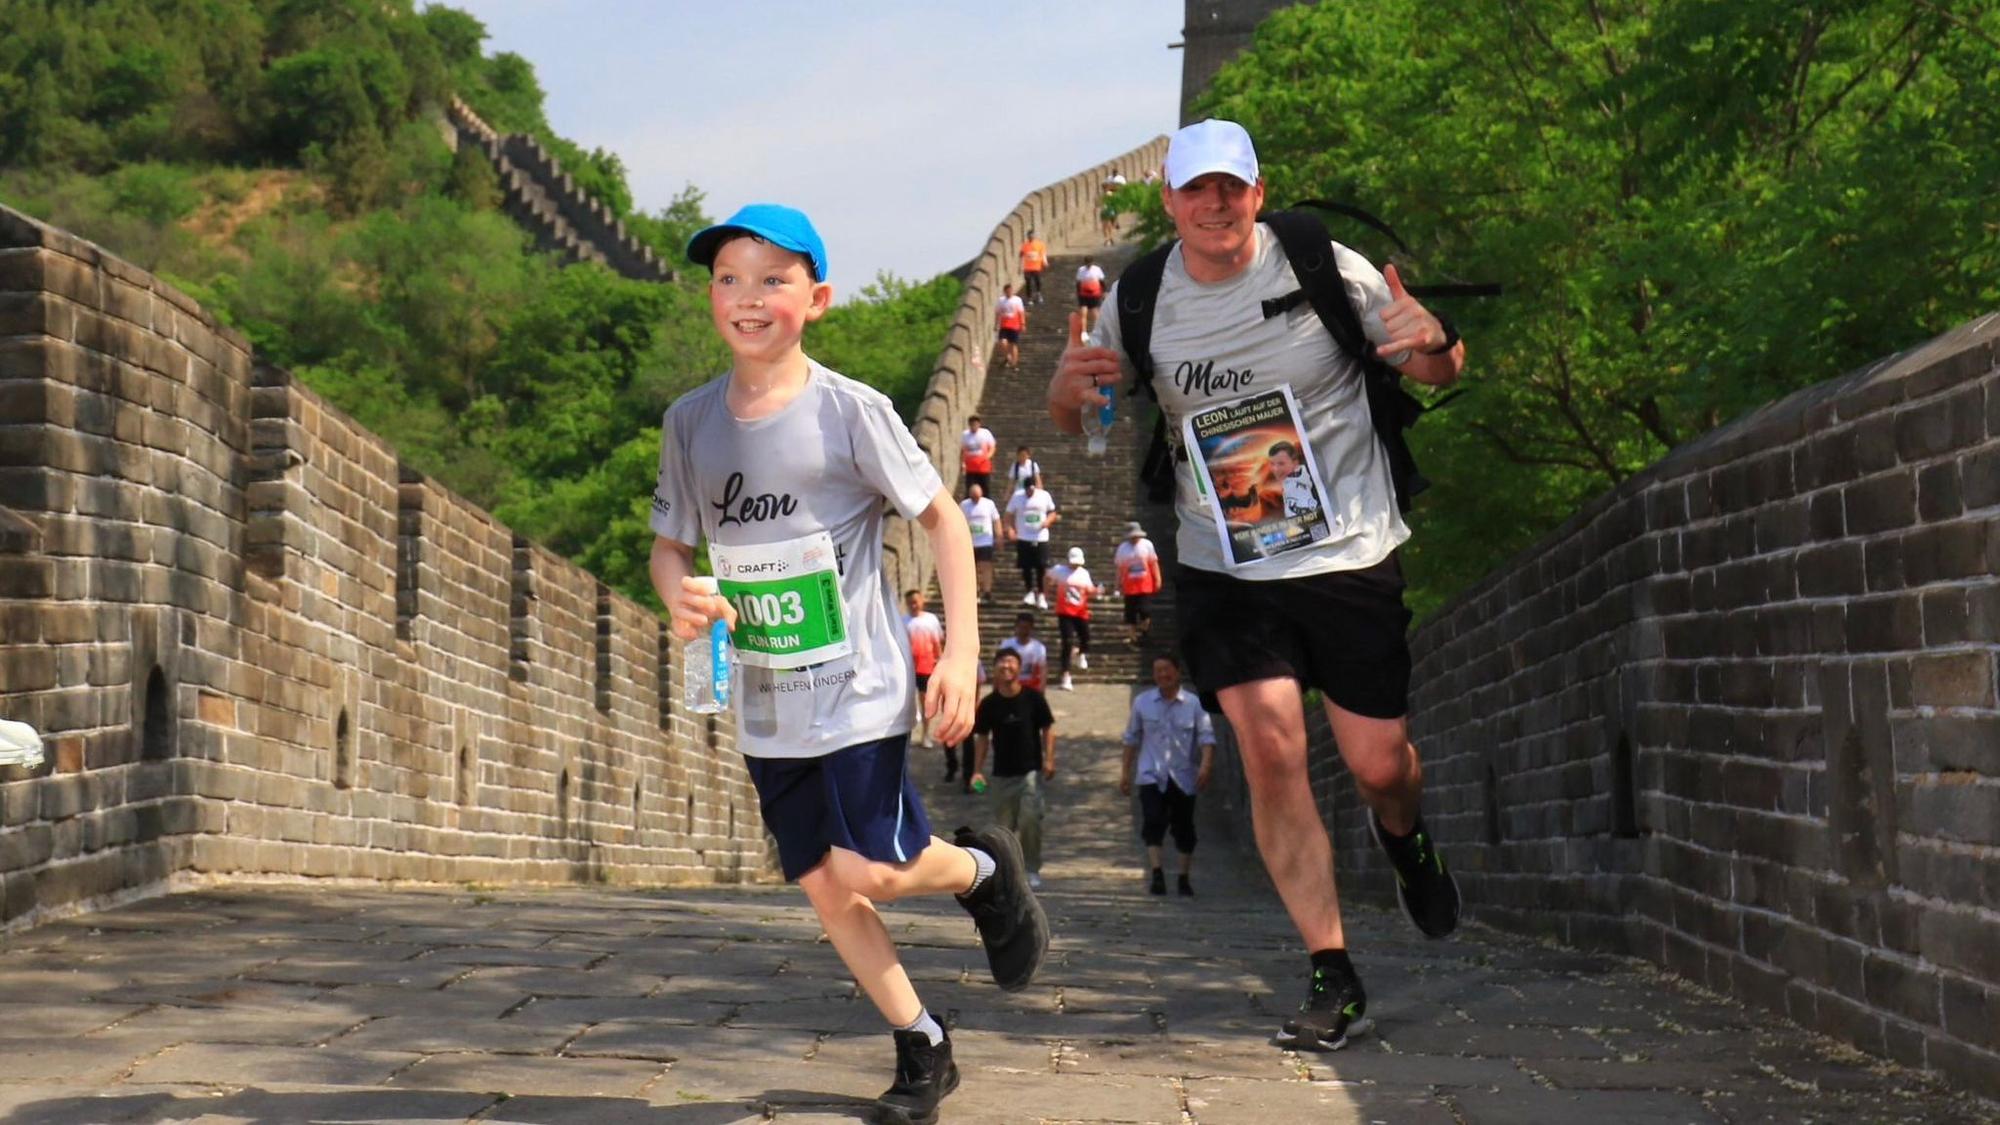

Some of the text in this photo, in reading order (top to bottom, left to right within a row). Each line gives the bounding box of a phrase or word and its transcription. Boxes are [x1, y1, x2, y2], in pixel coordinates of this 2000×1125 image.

[1175, 360, 1254, 396] Marc
[1196, 409, 1229, 428] LEON
[712, 472, 797, 527] Leon
[737, 562, 776, 574] CRAFT
[733, 591, 804, 627] 1003
[748, 634, 800, 649] FUN RUN
